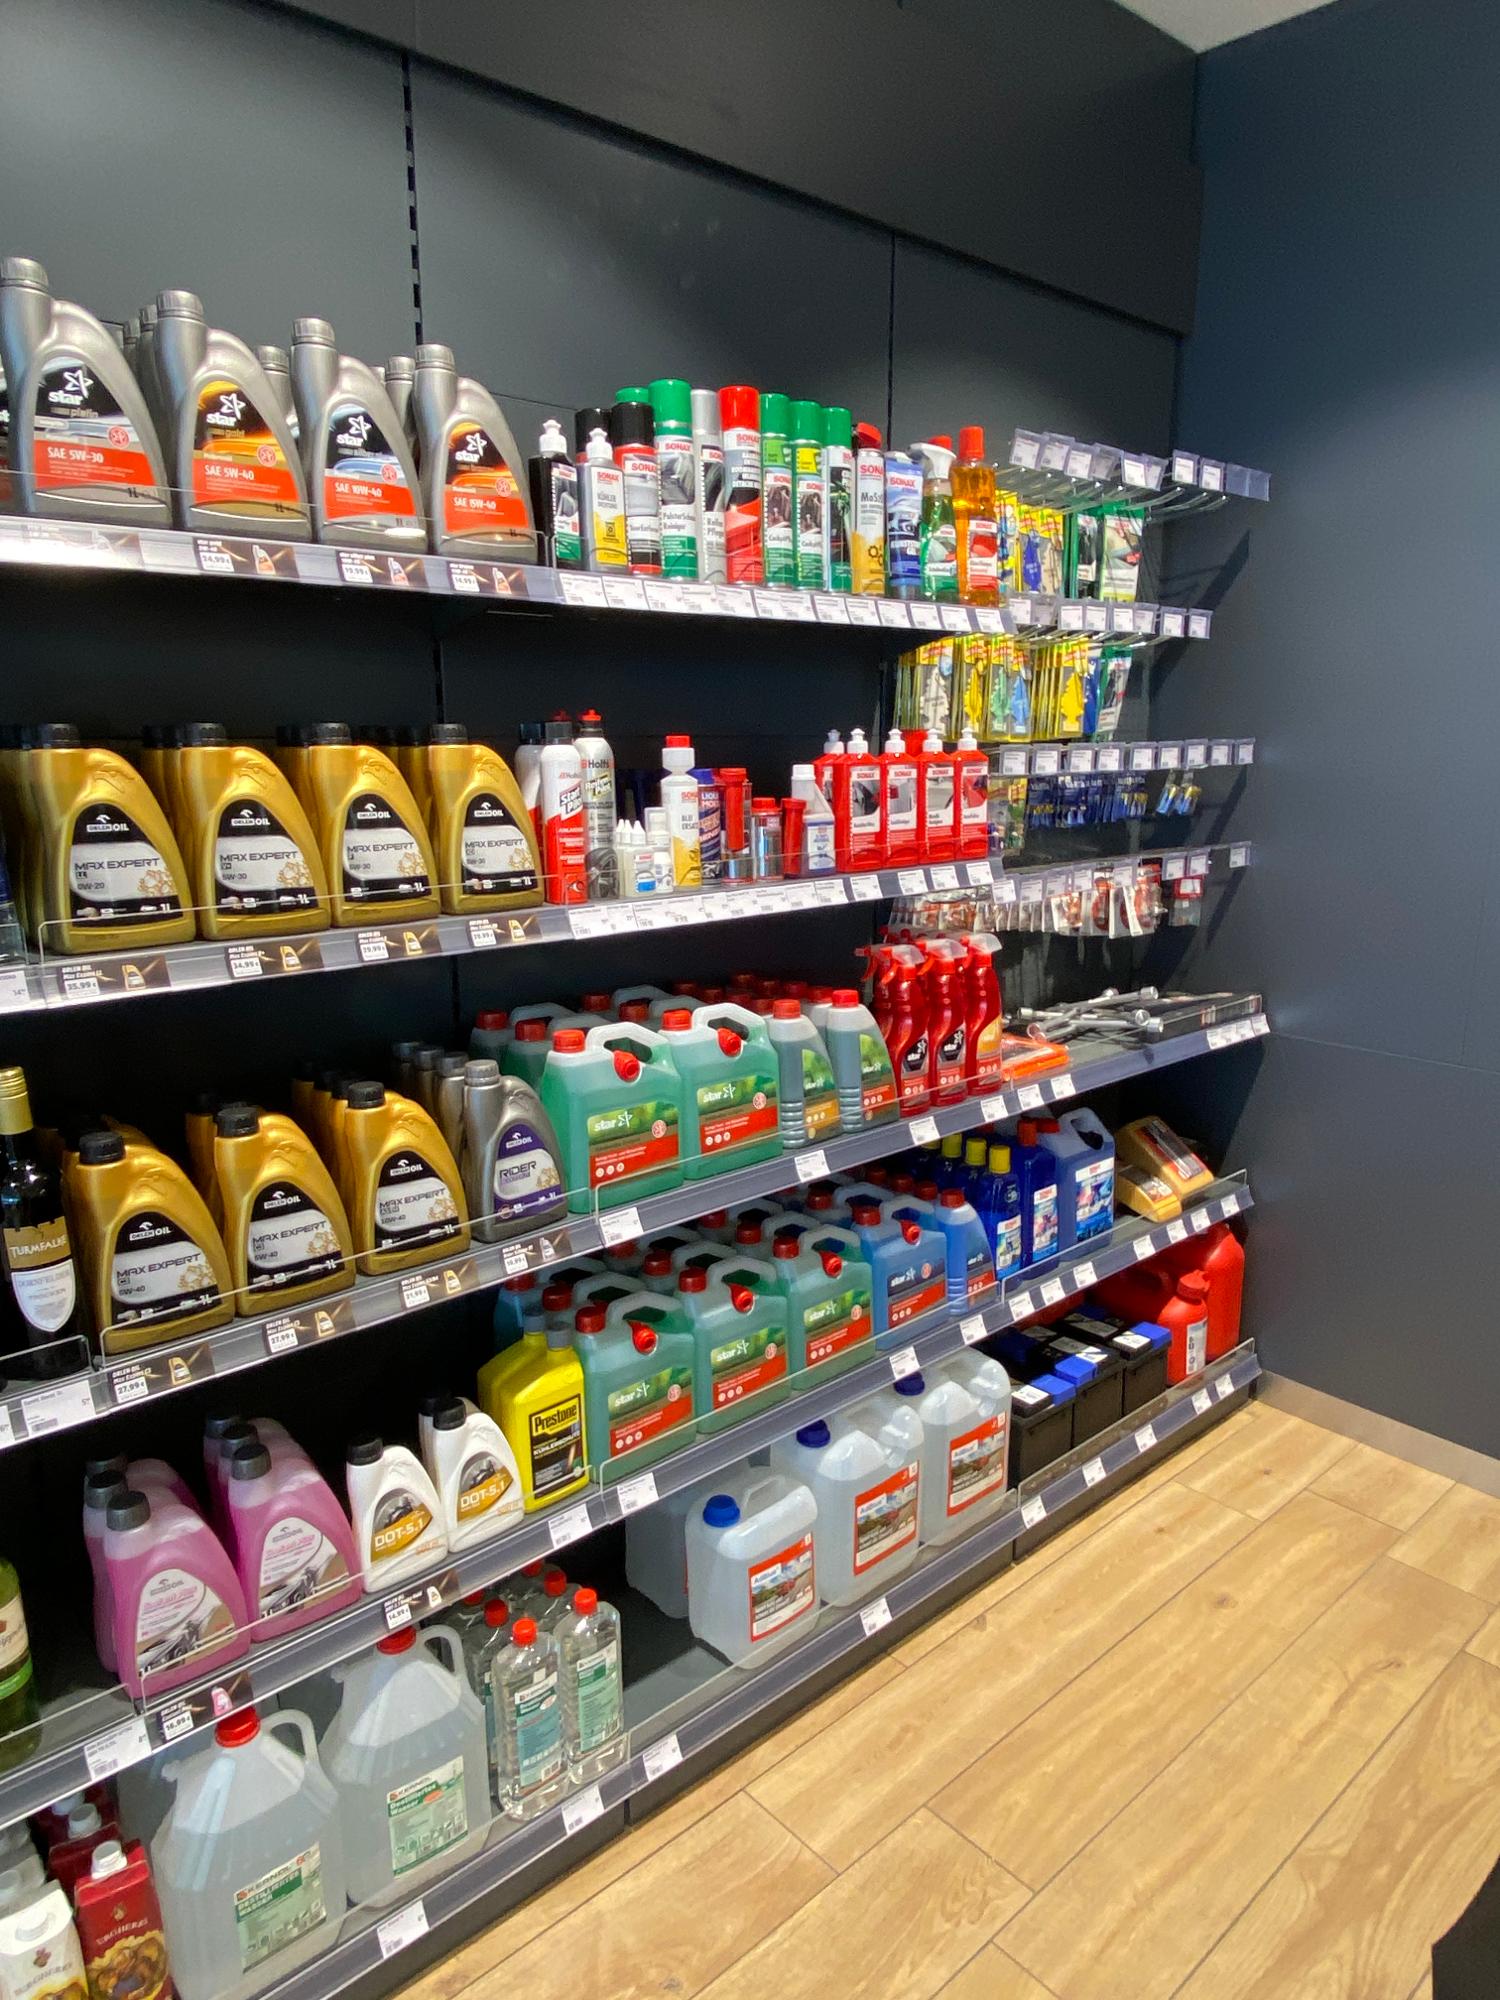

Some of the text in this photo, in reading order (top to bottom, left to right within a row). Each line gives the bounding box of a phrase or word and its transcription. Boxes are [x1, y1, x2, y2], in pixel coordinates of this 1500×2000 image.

[48, 390, 83, 405] star
[206, 413, 237, 426] star
[336, 434, 363, 446] star
[665, 443, 691, 451] SONAX
[48, 447, 104, 463] SAE 5W-30
[455, 450, 480, 463] star
[205, 465, 254, 480] SAE 5W-40
[632, 463, 657, 472] SONA
[597, 472, 619, 481] SONAX
[889, 478, 915, 488] SONAX
[335, 482, 382, 497] SAE 10W-40
[454, 497, 467, 508] SAE
[113, 823, 130, 831] OIL
[347, 842, 414, 853] MAX EXPERT
[487, 839, 523, 848] EXPERT
[220, 851, 298, 862] MAX EXPERT
[75, 858, 160, 871] MAX EXPERT
[704, 1092, 722, 1103] star
[595, 1120, 617, 1132] star
[410, 1164, 423, 1172] OIL
[500, 1161, 537, 1178] RIDER
[287, 1195, 301, 1204] OIL
[379, 1188, 446, 1208] MAX EXPERT
[155, 1226, 172, 1236] OIL
[252, 1220, 326, 1243] MAX EXPERT
[117, 1253, 201, 1278] MAX EXPERT
[891, 1275, 906, 1288] star
[810, 1309, 827, 1322] star
[716, 1347, 736, 1361] star
[615, 1392, 636, 1407] star
[534, 1404, 577, 1432] Prestone
[460, 1481, 505, 1509] DOT-5.1
[375, 1518, 424, 1547] DOT-5.1
